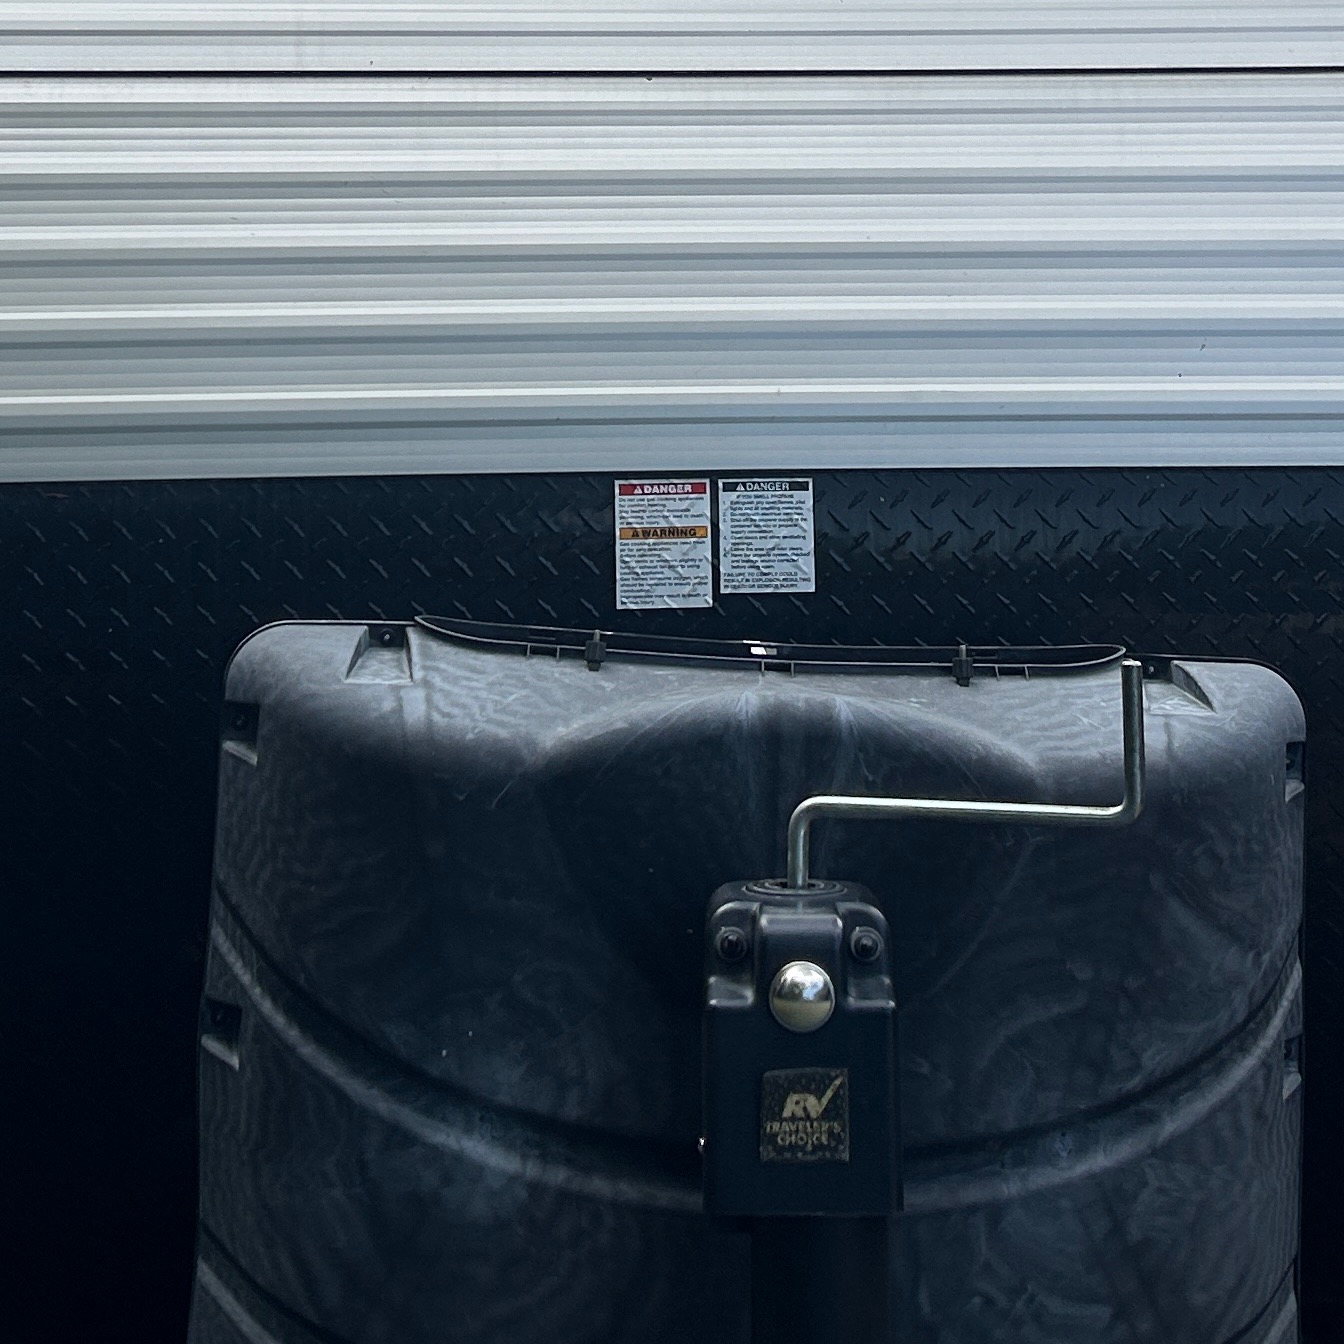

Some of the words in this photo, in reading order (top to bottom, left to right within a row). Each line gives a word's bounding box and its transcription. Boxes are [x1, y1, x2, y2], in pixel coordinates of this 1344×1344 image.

[643, 484, 692, 494] DANGER
[745, 482, 790, 491] DANGER
[642, 528, 697, 538] WARNING
[782, 1076, 844, 1119] RV
